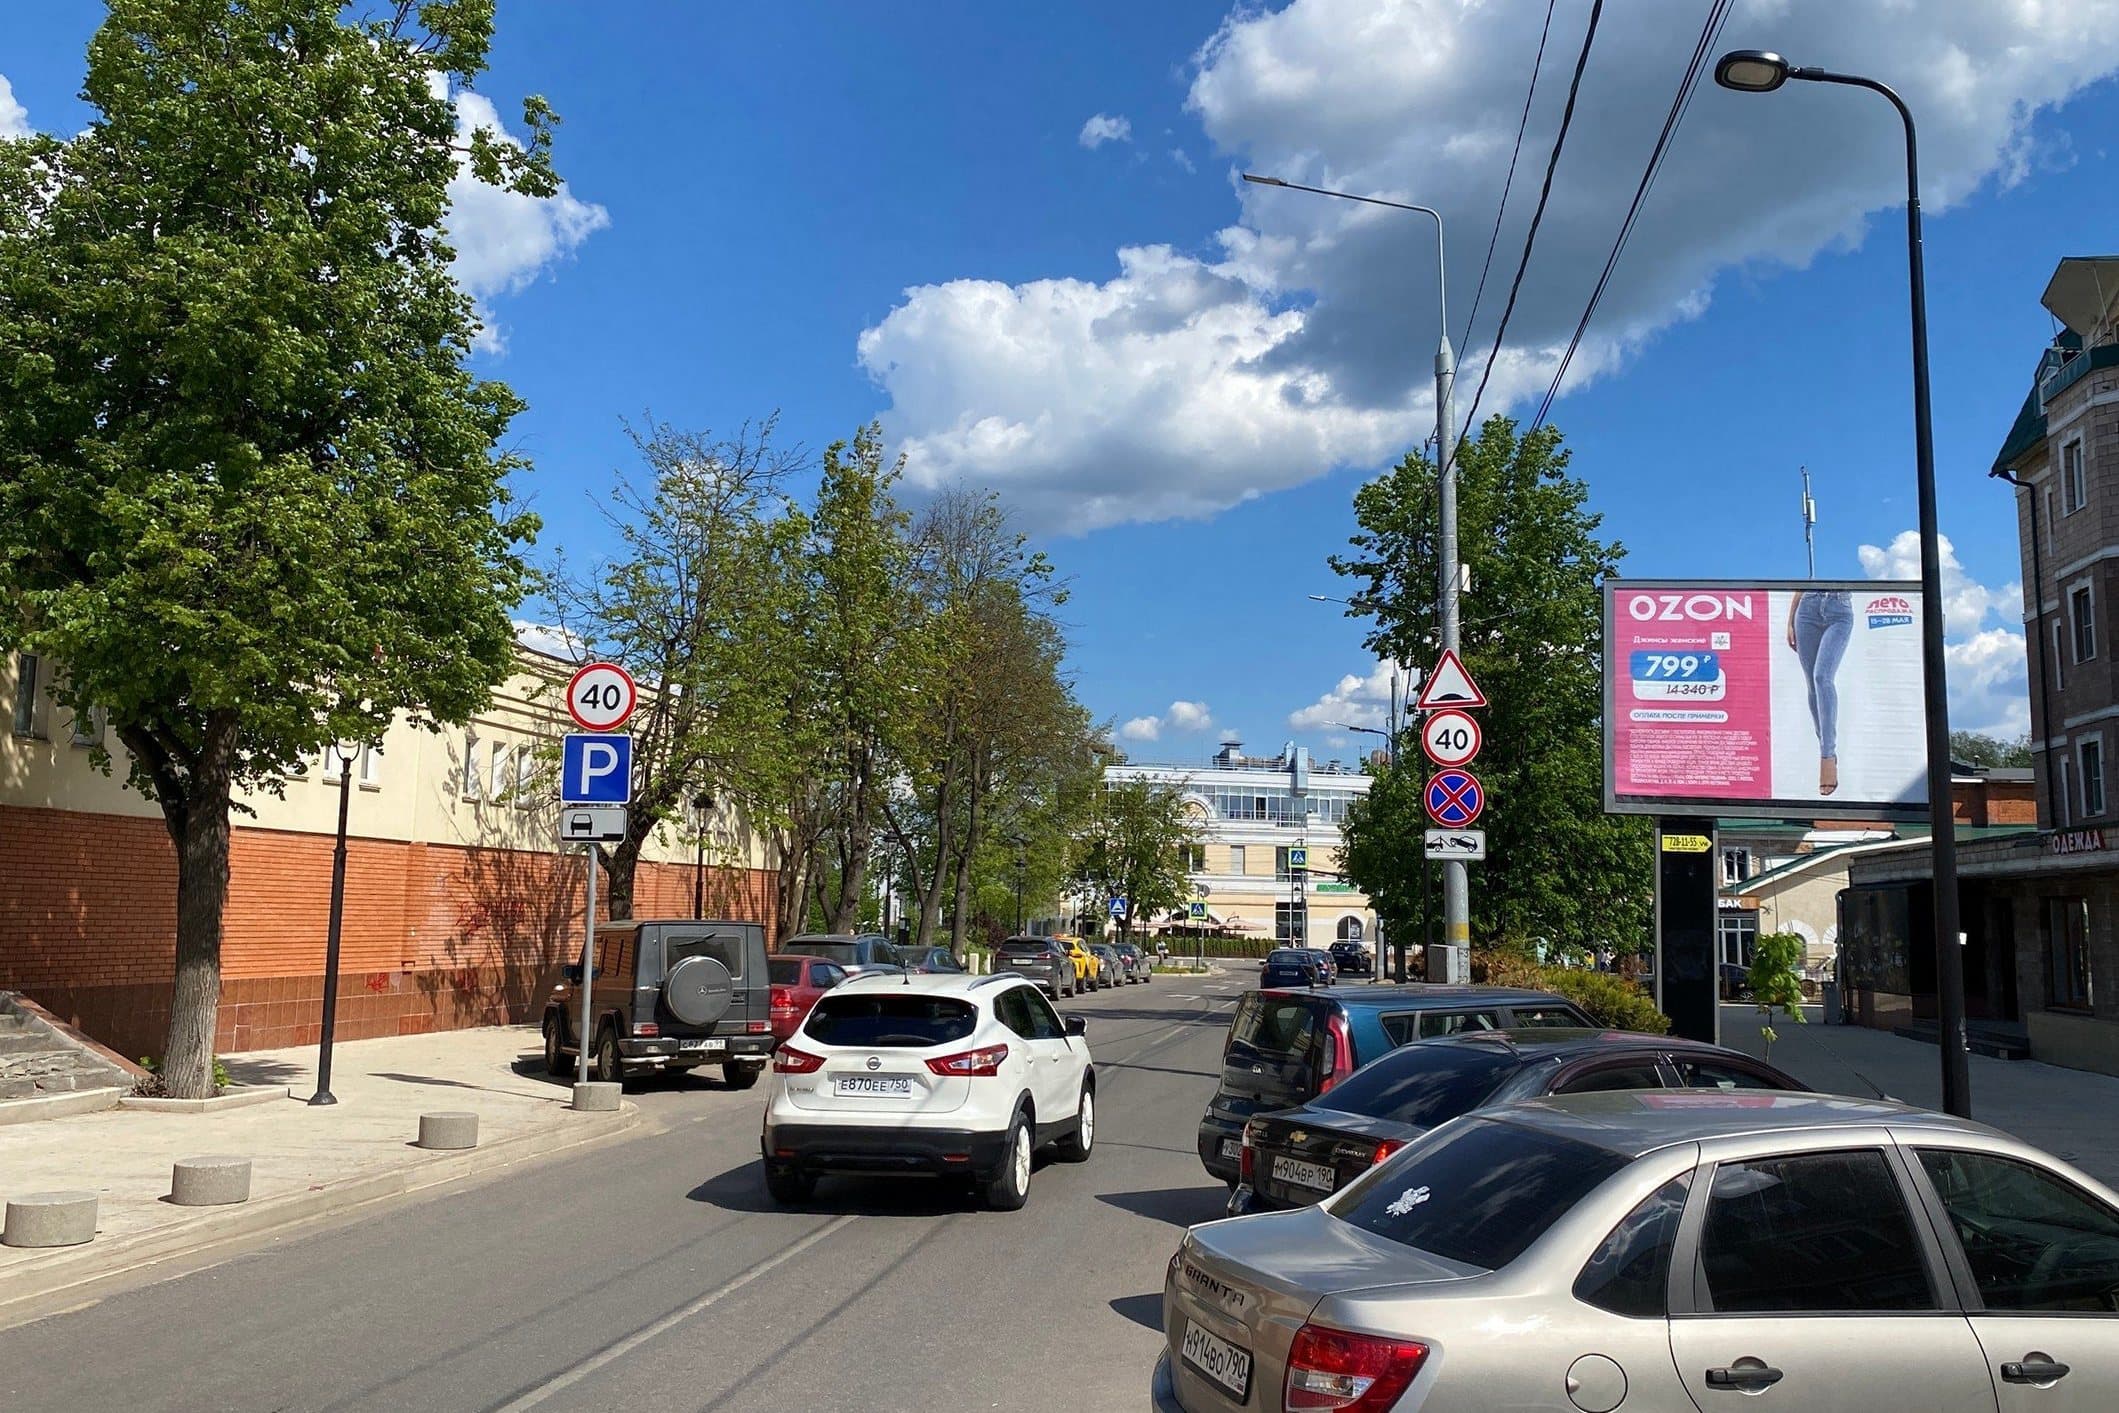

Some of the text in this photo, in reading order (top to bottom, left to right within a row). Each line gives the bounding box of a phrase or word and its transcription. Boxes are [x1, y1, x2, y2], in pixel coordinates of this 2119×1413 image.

[1629, 595, 1752, 620] OZON
[1645, 655, 1699, 677] 799
[580, 684, 621, 711] 40
[1662, 712, 1686, 720] ПОСЛЕ
[1435, 728, 1469, 750] 40
[580, 742, 619, 795] P
[2052, 829, 2101, 854] ОДЕЖДА
[889, 1078, 908, 1089] 750
[1186, 1264, 1245, 1307] GRANTA
[1226, 1347, 1246, 1379] 790
